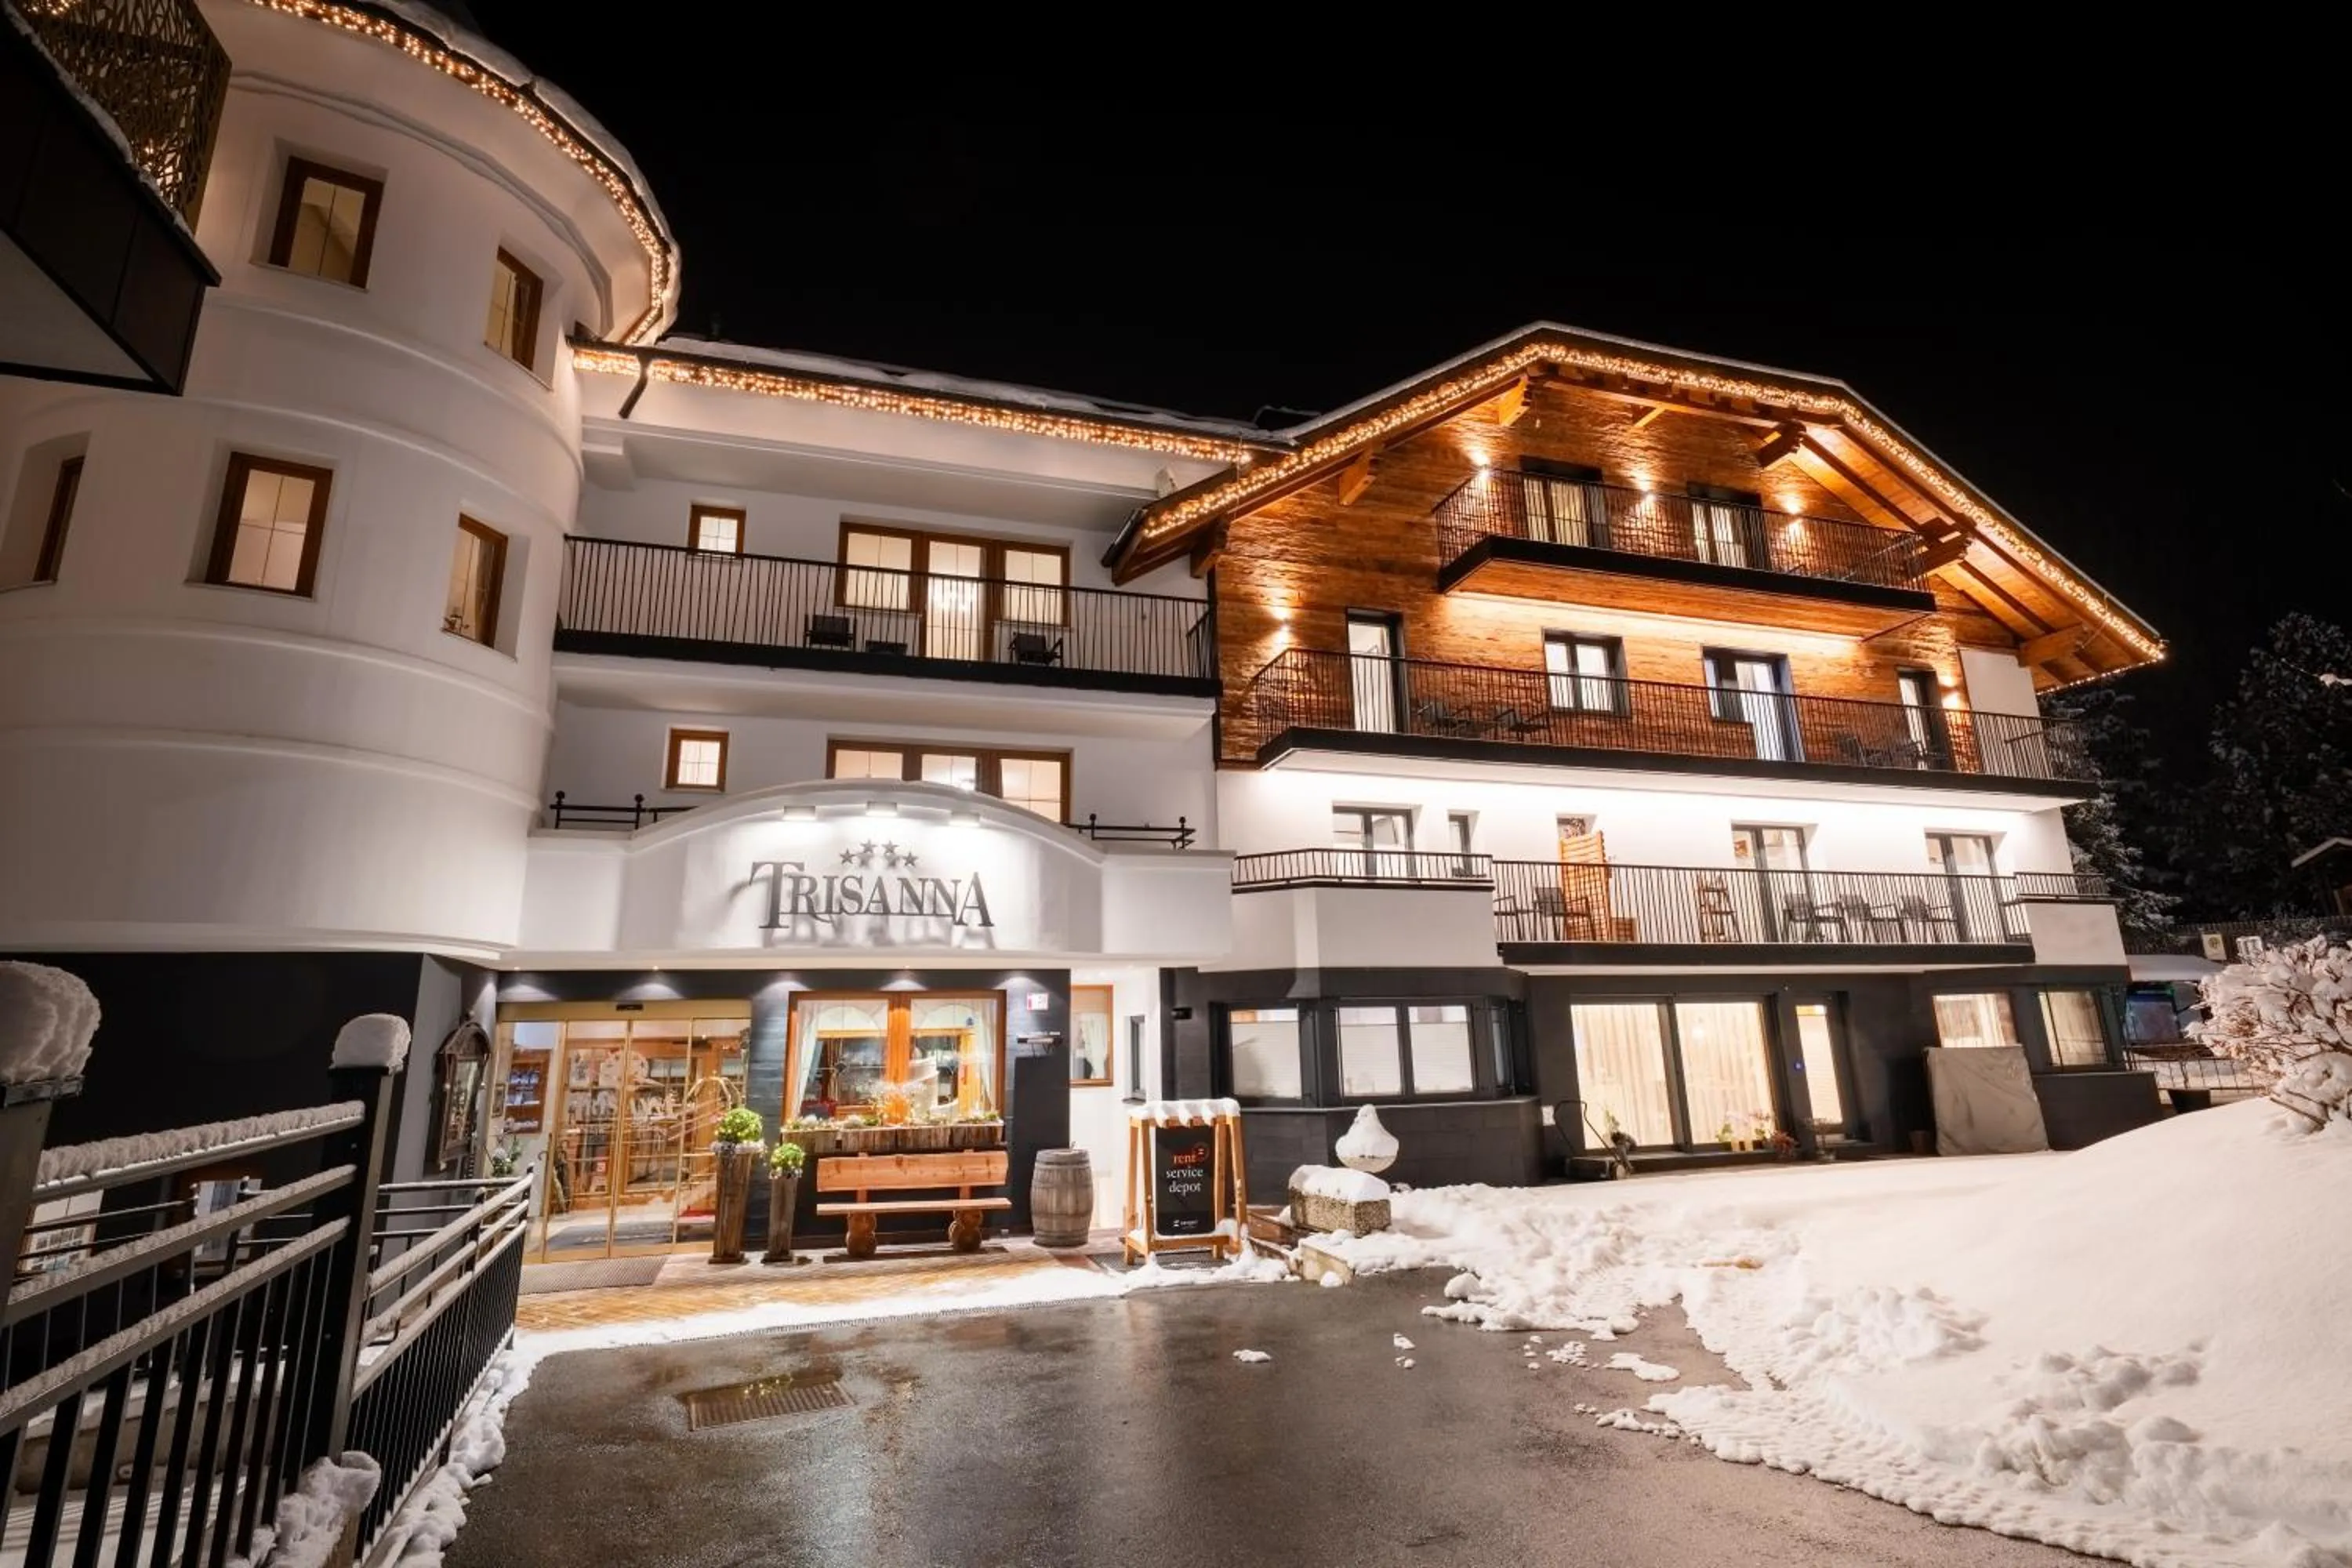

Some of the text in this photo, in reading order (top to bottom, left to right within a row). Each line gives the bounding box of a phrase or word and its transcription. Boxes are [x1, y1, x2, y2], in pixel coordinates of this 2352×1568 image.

[749, 861, 995, 928] TRISANNA
[1174, 1153, 1196, 1164] rent
[1166, 1166, 1204, 1178] service
[1169, 1180, 1202, 1197] depot
